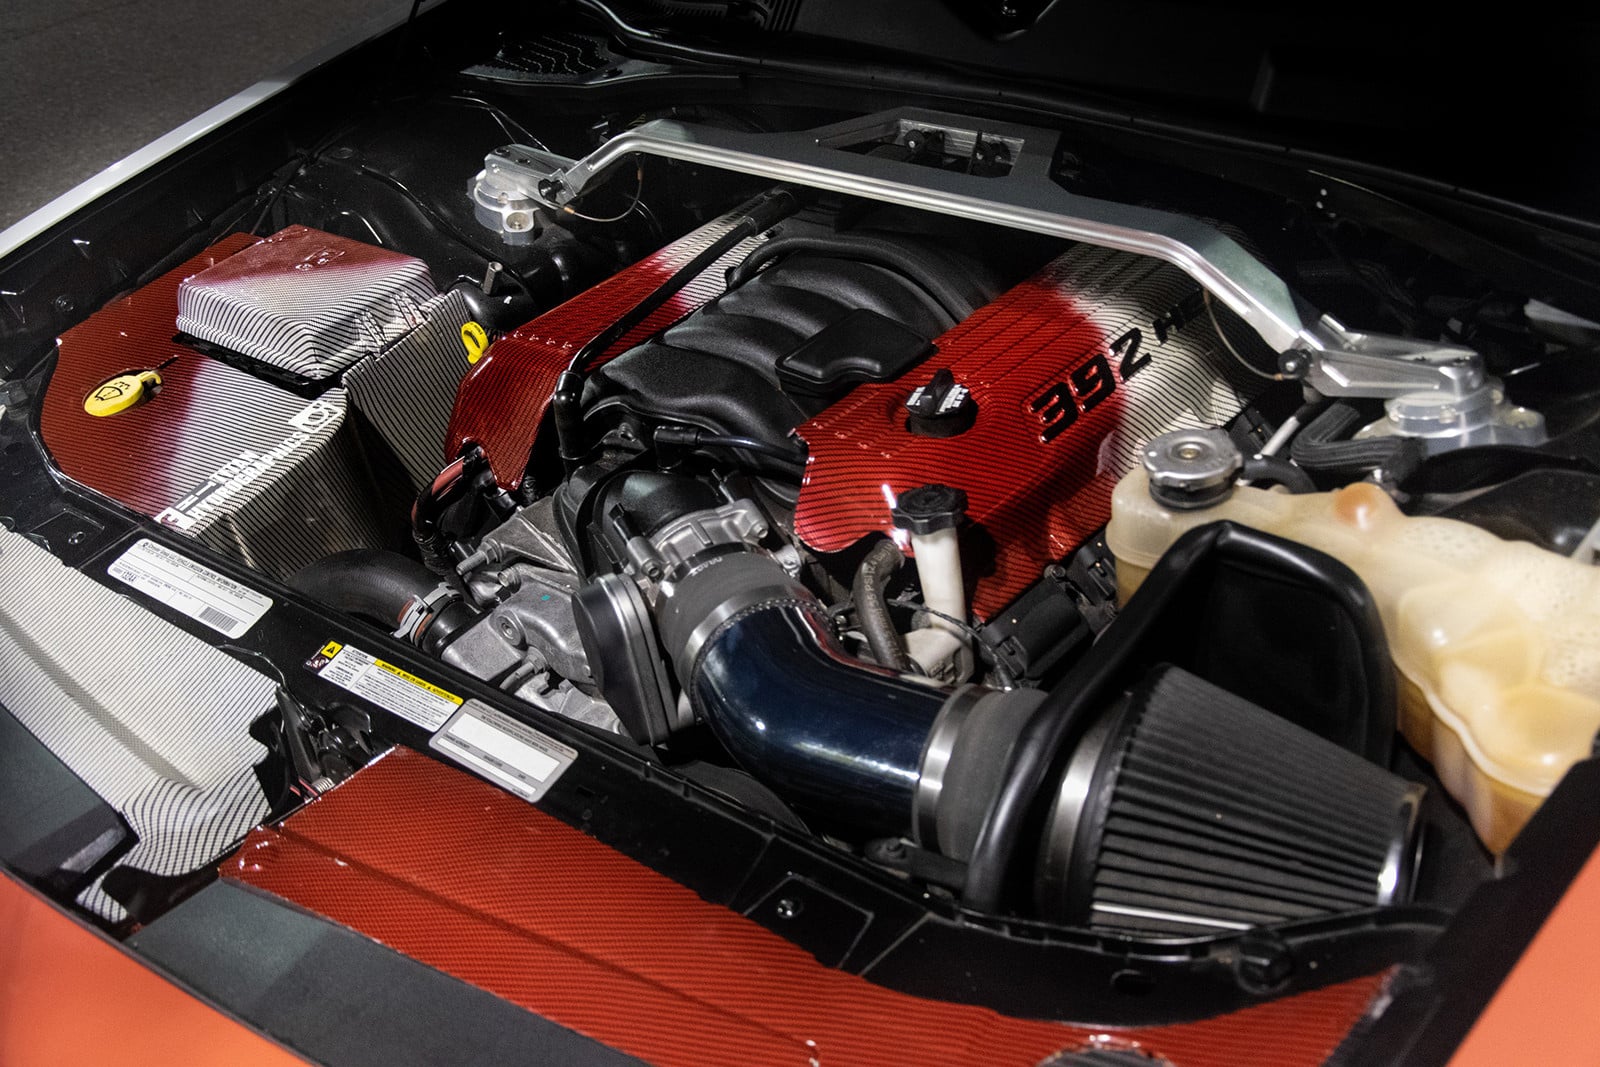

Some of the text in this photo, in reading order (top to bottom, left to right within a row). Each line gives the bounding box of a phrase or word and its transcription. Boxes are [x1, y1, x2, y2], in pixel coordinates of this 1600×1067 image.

[1027, 328, 1153, 444] 392
[185, 431, 310, 520] HYDROGRAPHICS
[210, 450, 261, 485] TITAN
